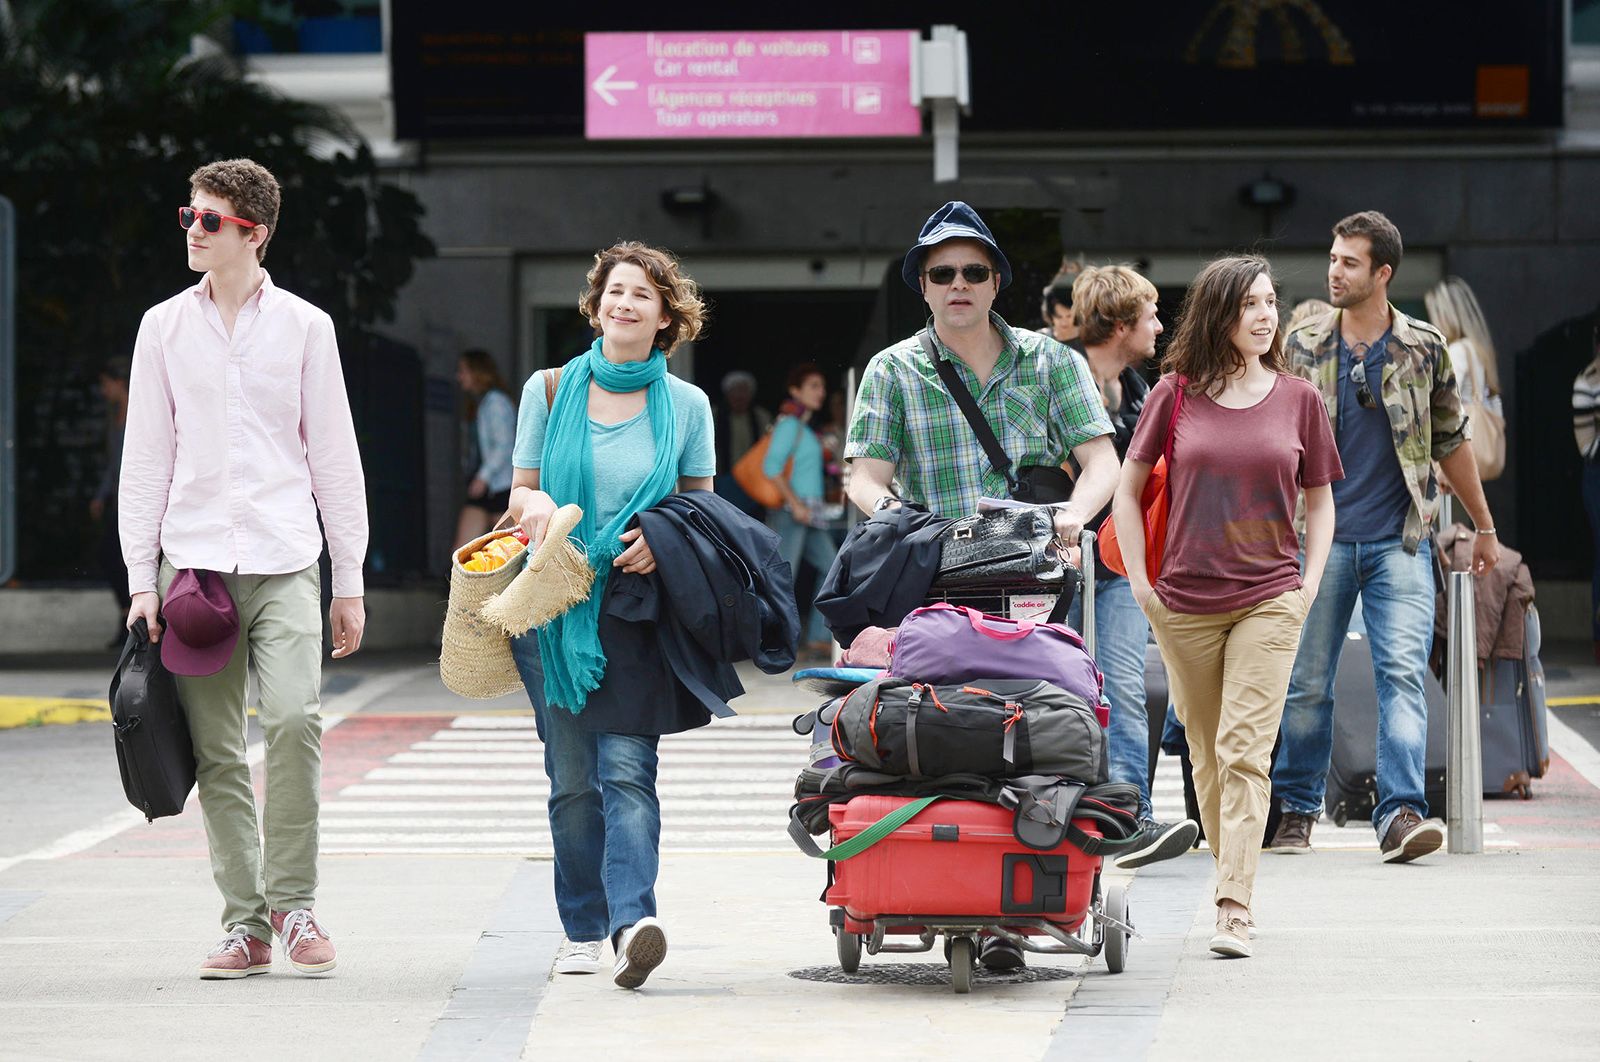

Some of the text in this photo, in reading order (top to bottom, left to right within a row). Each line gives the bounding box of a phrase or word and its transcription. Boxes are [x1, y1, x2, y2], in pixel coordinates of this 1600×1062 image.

[655, 39, 830, 56] Location de voitures
[654, 58, 739, 76] Car rental
[657, 90, 724, 111] Agences
[656, 108, 779, 128] Tour operators
